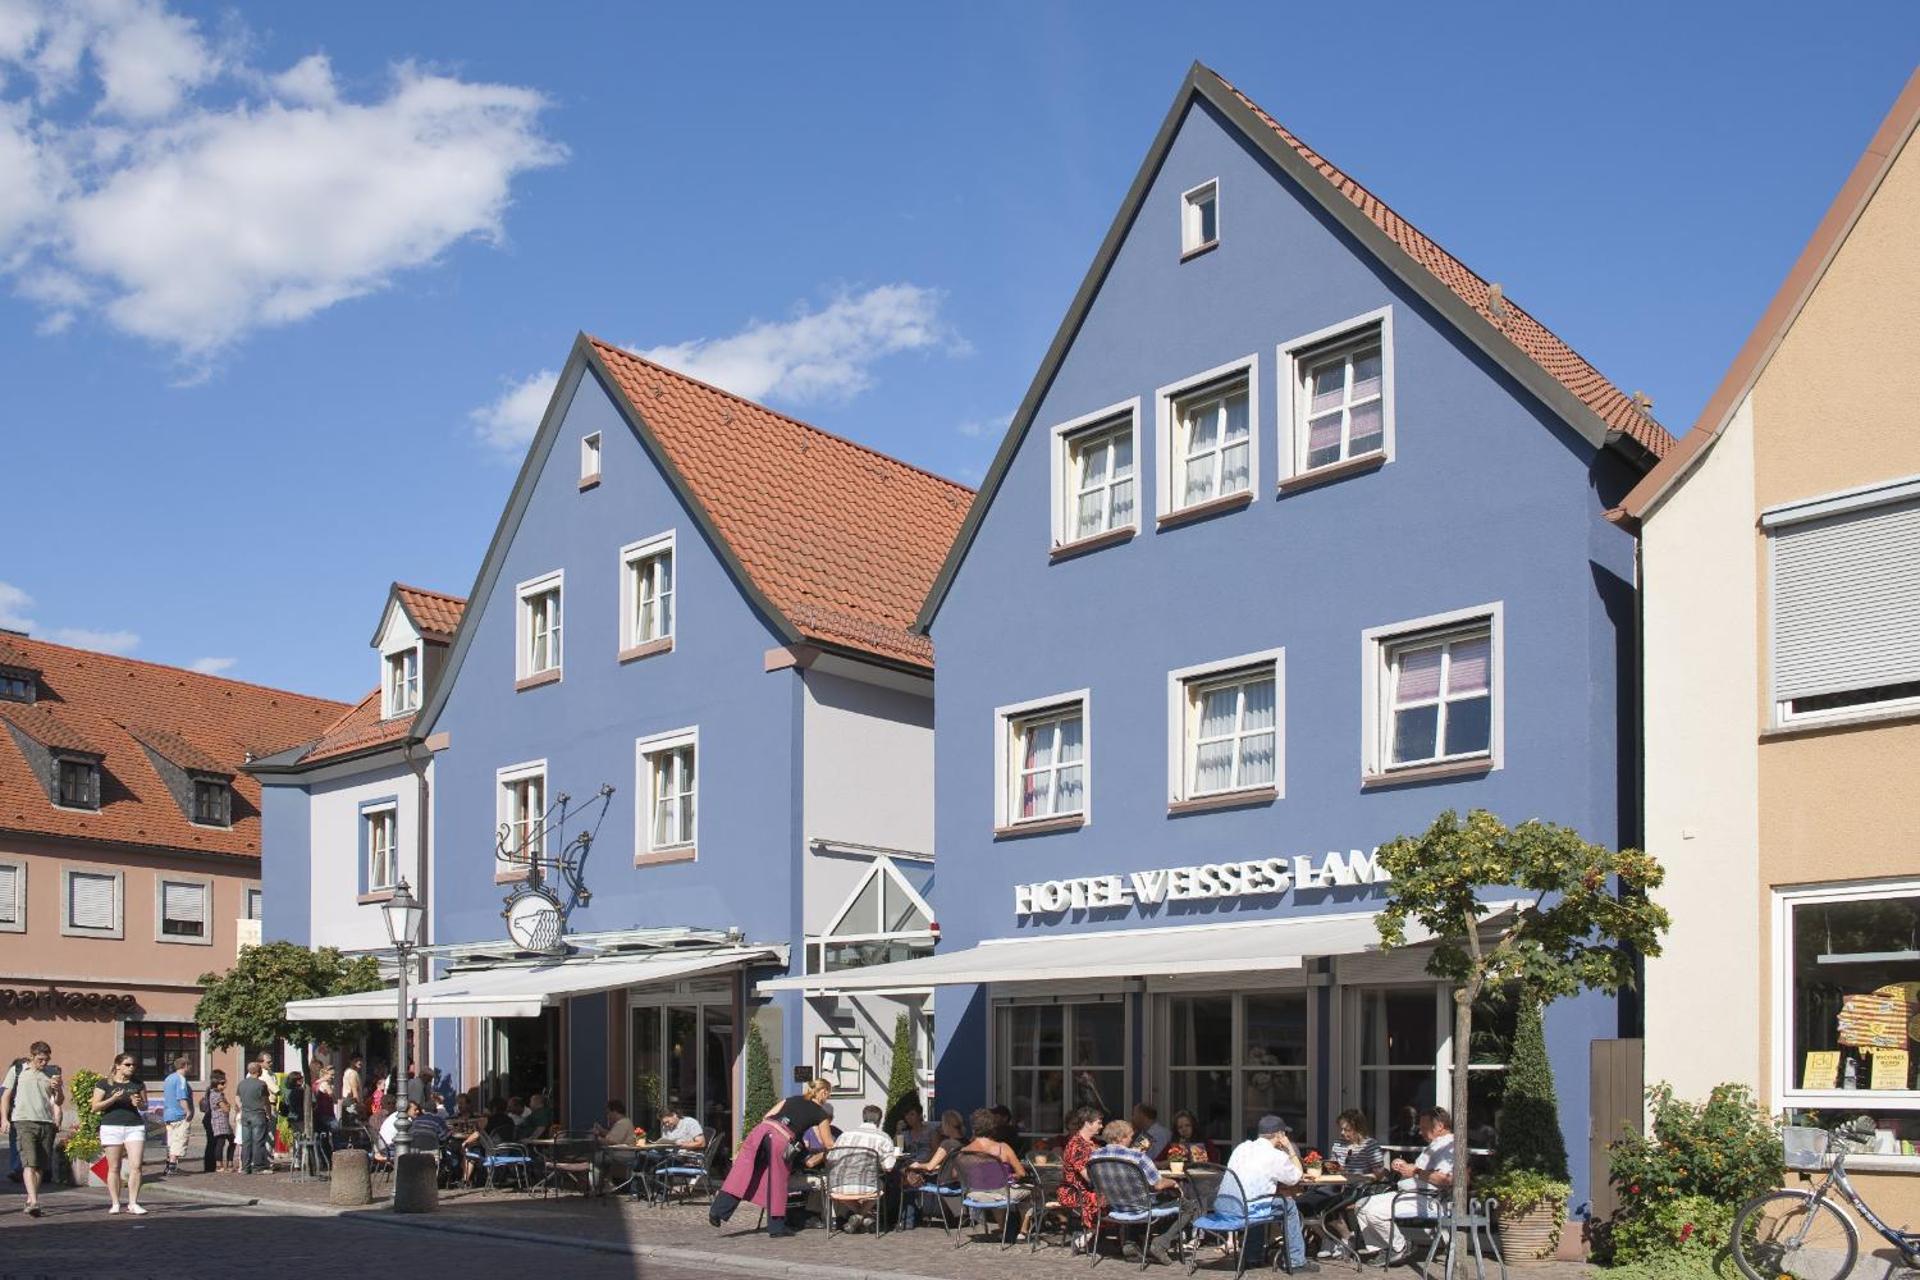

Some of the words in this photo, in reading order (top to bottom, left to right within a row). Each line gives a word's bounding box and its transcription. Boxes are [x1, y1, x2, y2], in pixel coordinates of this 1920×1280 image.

[1013, 873, 1134, 915] HOTEL
[1129, 857, 1290, 904] WEISSES
[1293, 846, 1393, 890] LAM
